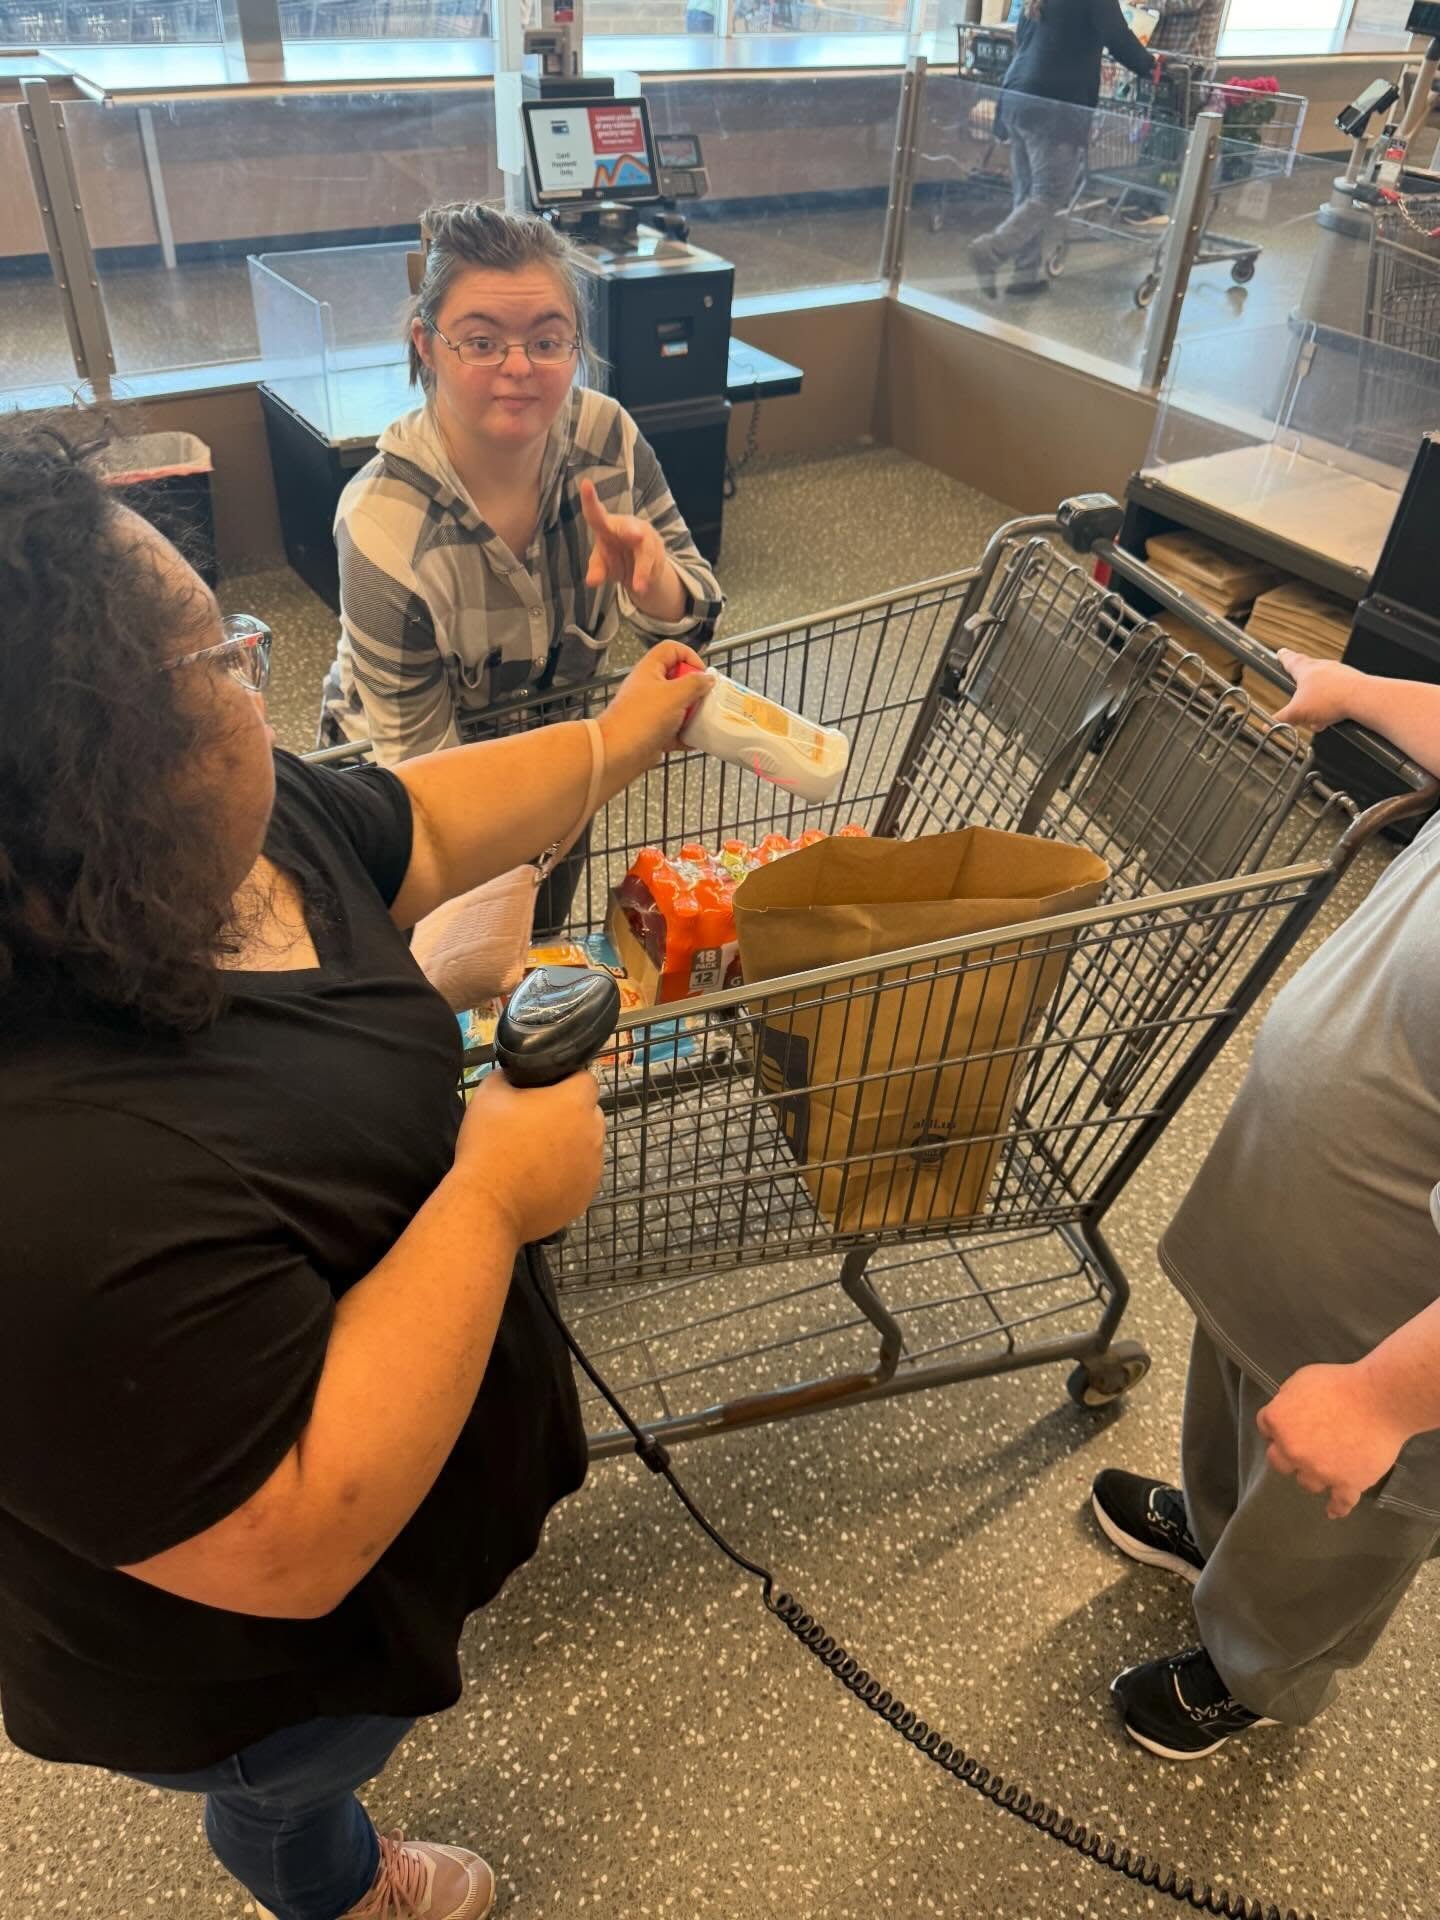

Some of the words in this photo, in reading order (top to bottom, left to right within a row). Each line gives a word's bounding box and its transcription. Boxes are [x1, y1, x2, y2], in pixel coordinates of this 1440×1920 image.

[697, 950, 717, 963] 18
[695, 962, 717, 970] PACK
[695, 972, 714, 983] 12
